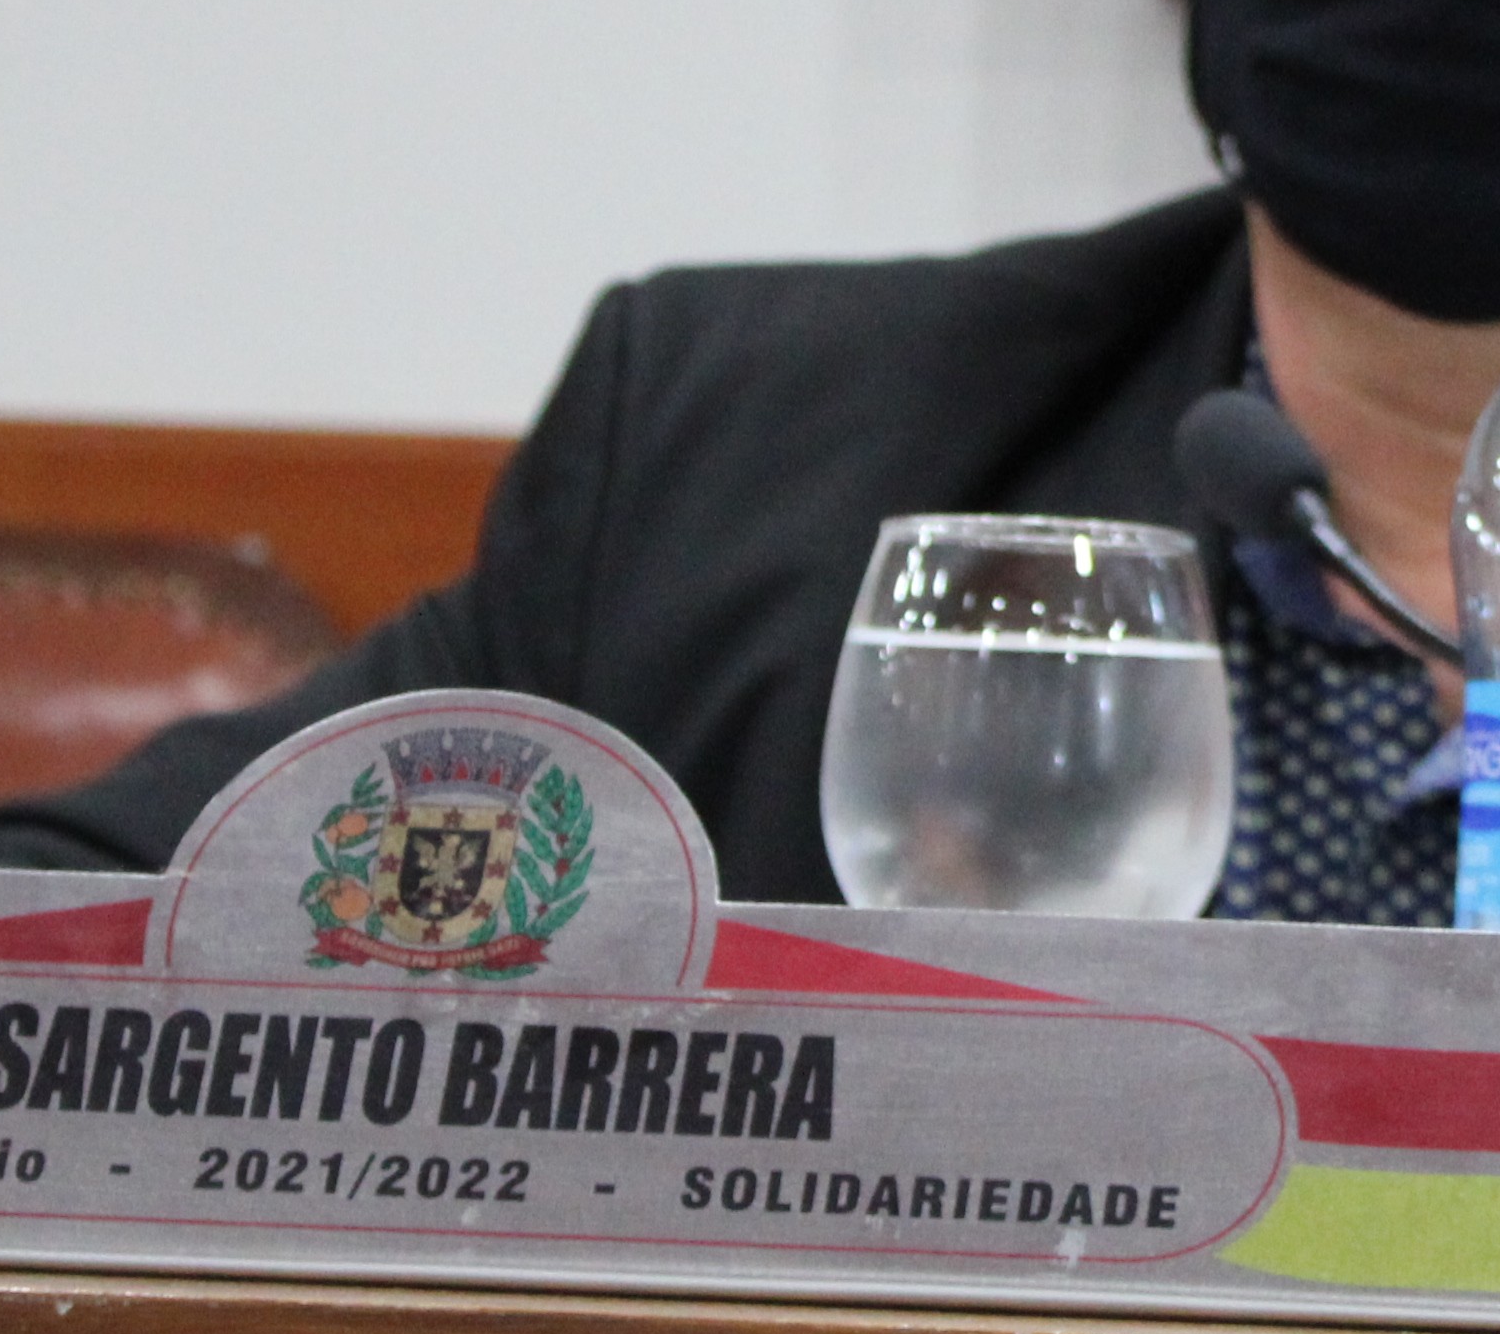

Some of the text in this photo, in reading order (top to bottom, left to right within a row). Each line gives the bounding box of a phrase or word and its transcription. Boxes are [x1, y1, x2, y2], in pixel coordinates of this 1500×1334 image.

[438, 1021, 836, 1142] BARRERA
[193, 1146, 530, 1203] 2021/2022
[680, 1165, 1180, 1229] SOLIDARIEDADE
